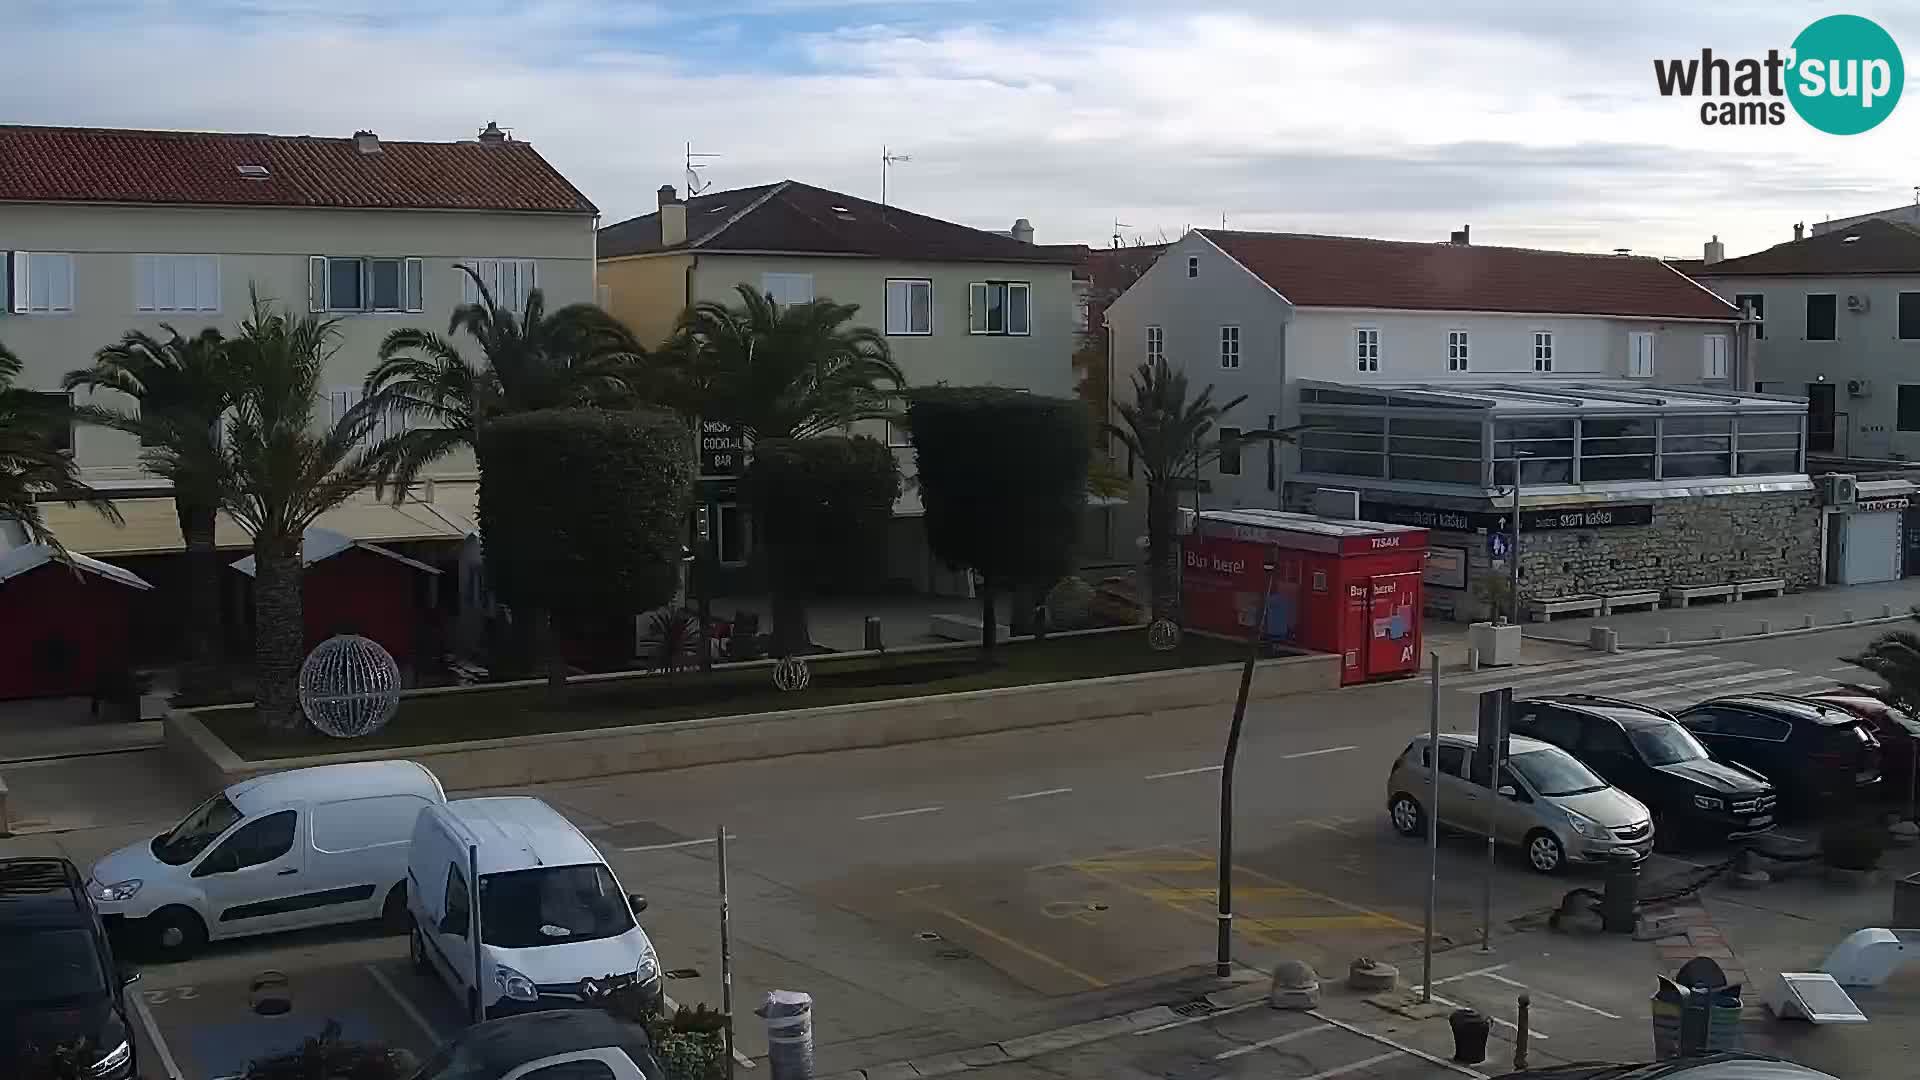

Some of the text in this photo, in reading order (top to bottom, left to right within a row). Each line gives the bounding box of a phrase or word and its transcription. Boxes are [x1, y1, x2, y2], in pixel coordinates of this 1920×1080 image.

[704, 421, 731, 432] SHISH
[715, 455, 731, 466] BAR
[1371, 536, 1400, 549] TISAK
[1350, 582, 1396, 599] Buy here!
